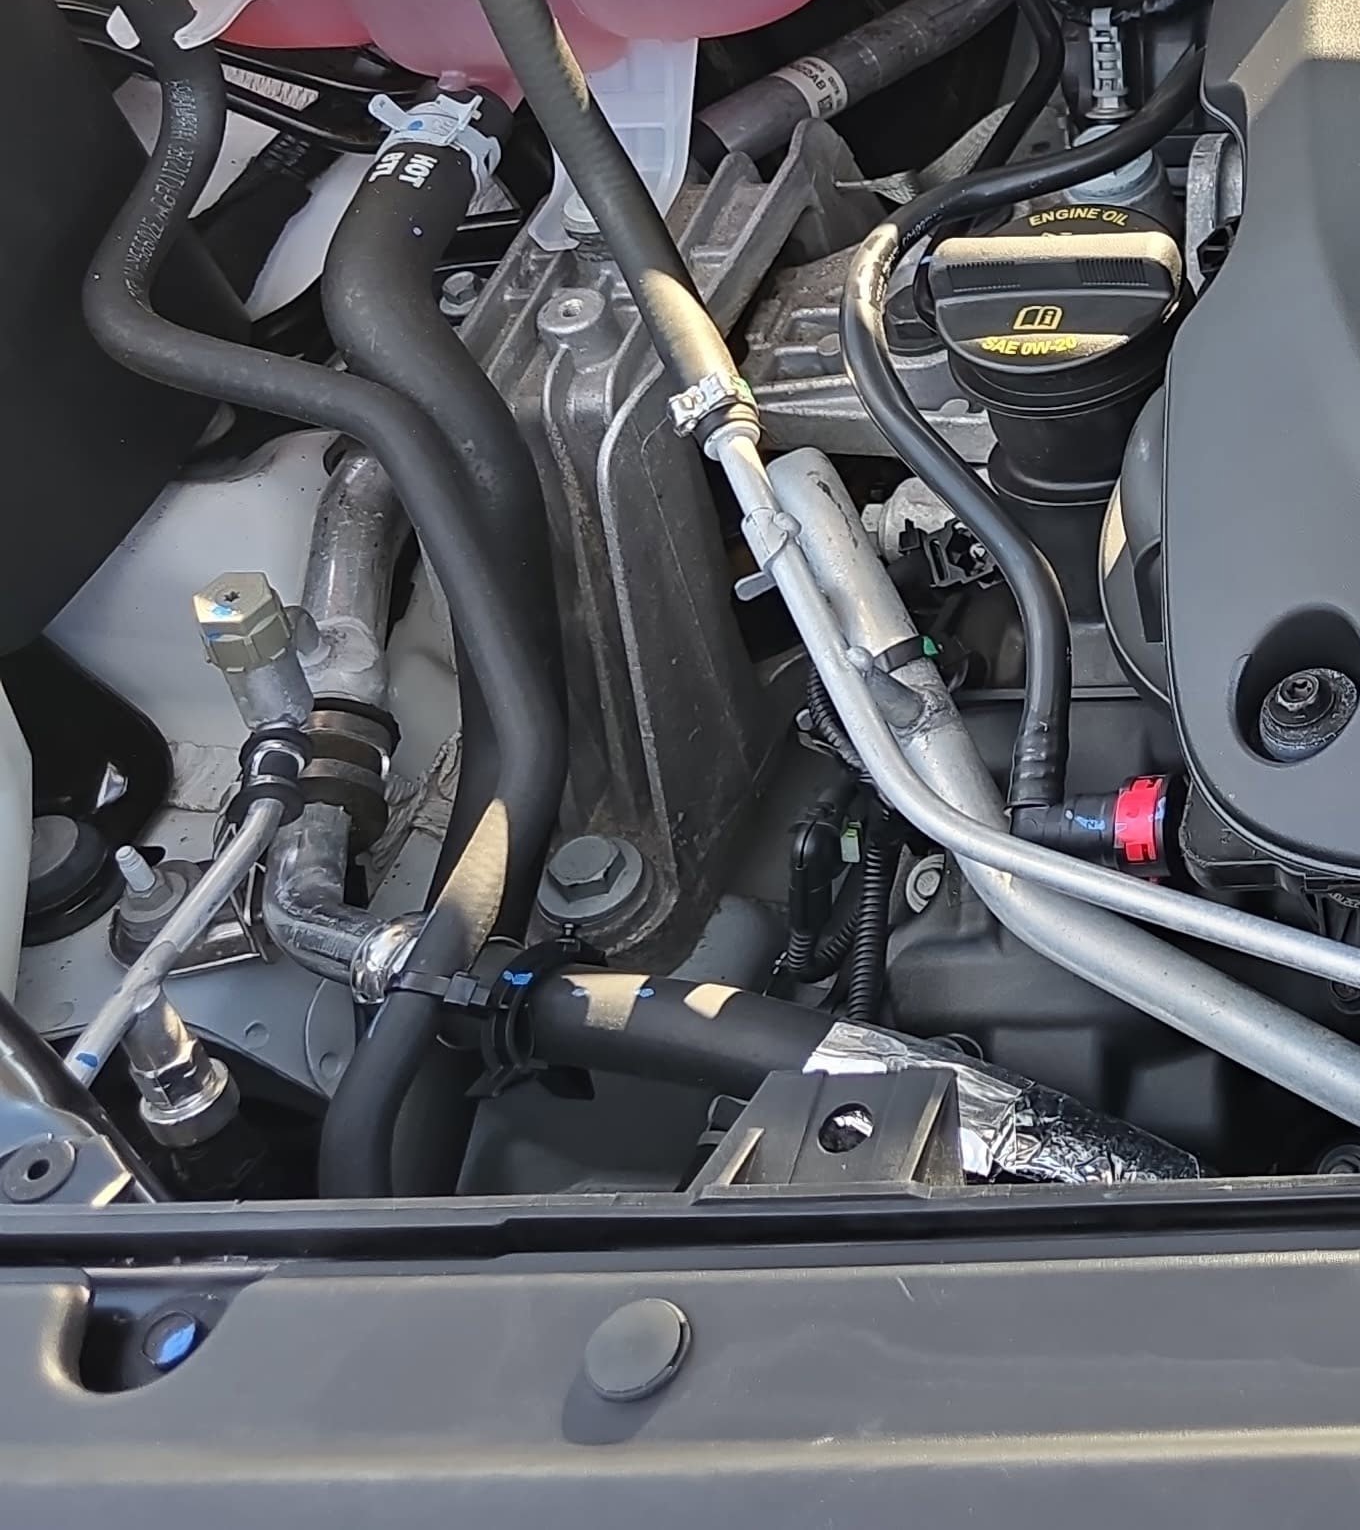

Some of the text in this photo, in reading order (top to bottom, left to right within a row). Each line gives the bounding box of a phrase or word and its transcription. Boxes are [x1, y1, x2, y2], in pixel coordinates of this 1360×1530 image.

[398, 153, 438, 189] HOT
[1028, 207, 1130, 227] ENGINE OIL
[981, 336, 1078, 356] SAE 0W-20
